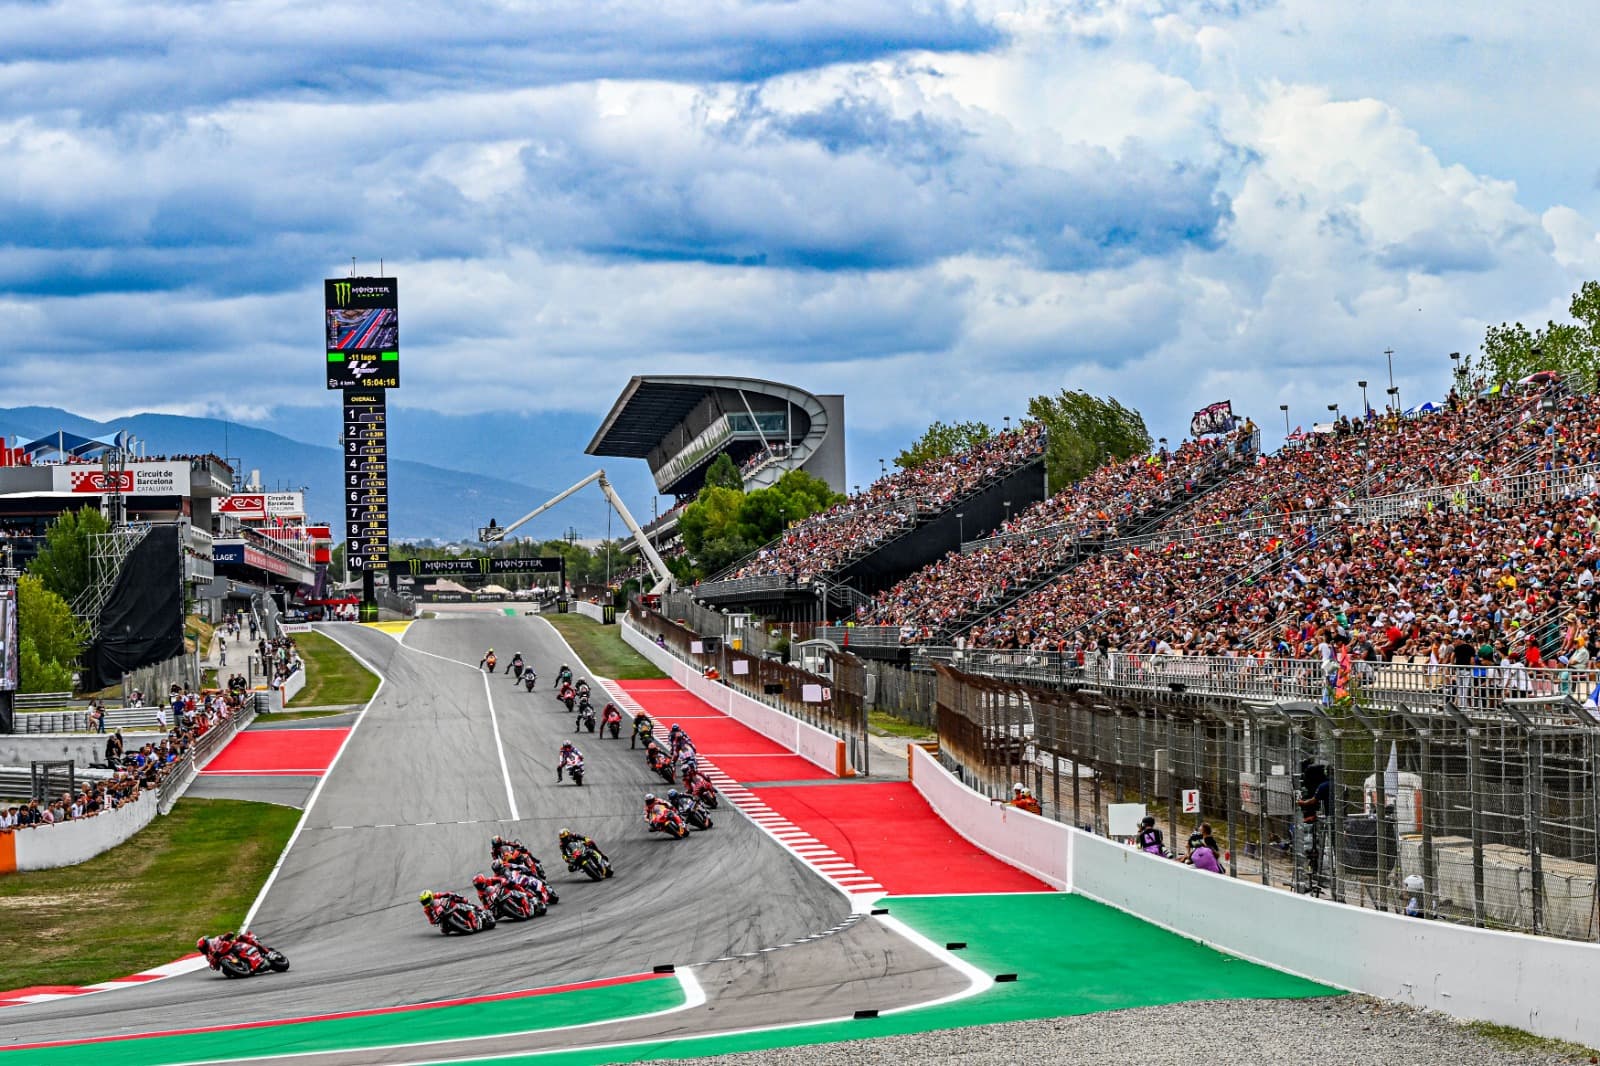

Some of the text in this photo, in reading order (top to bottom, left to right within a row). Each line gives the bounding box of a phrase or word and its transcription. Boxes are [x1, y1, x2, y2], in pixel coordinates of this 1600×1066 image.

[349, 409, 354, 419] 1
[349, 426, 356, 436] 2
[350, 442, 356, 452] 3
[350, 458, 357, 468] 4
[137, 470, 173, 478] Circuit de
[350, 475, 357, 485] 5
[351, 491, 358, 501] 6
[351, 508, 358, 518] 7
[351, 524, 358, 534] 8
[351, 541, 359, 550] 9
[349, 556, 362, 567] 10
[425, 560, 543, 569] MONSTER MONSTER
